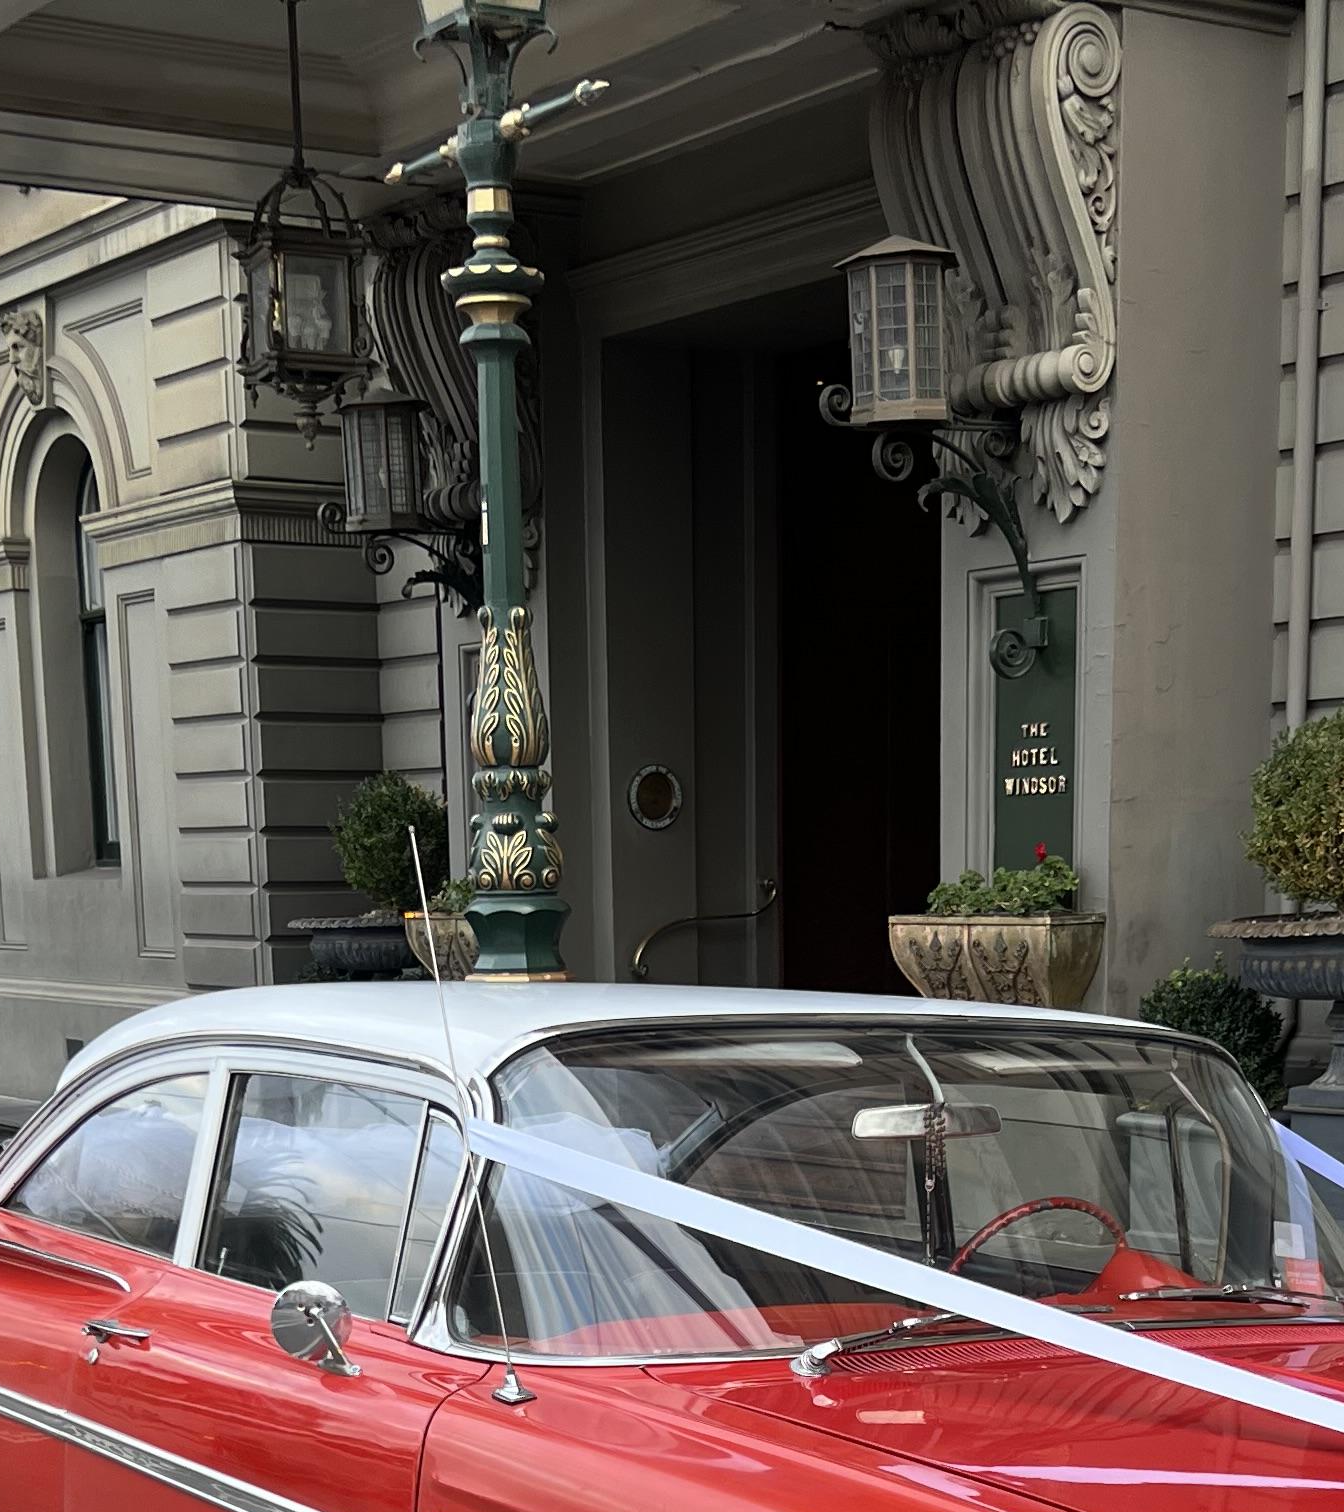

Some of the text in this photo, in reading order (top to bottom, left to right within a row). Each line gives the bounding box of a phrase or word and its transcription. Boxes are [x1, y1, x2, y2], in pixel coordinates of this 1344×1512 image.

[1020, 722, 1050, 738] THE
[1012, 747, 1059, 767] HOTEL
[1004, 775, 1067, 796] WINDSOR
